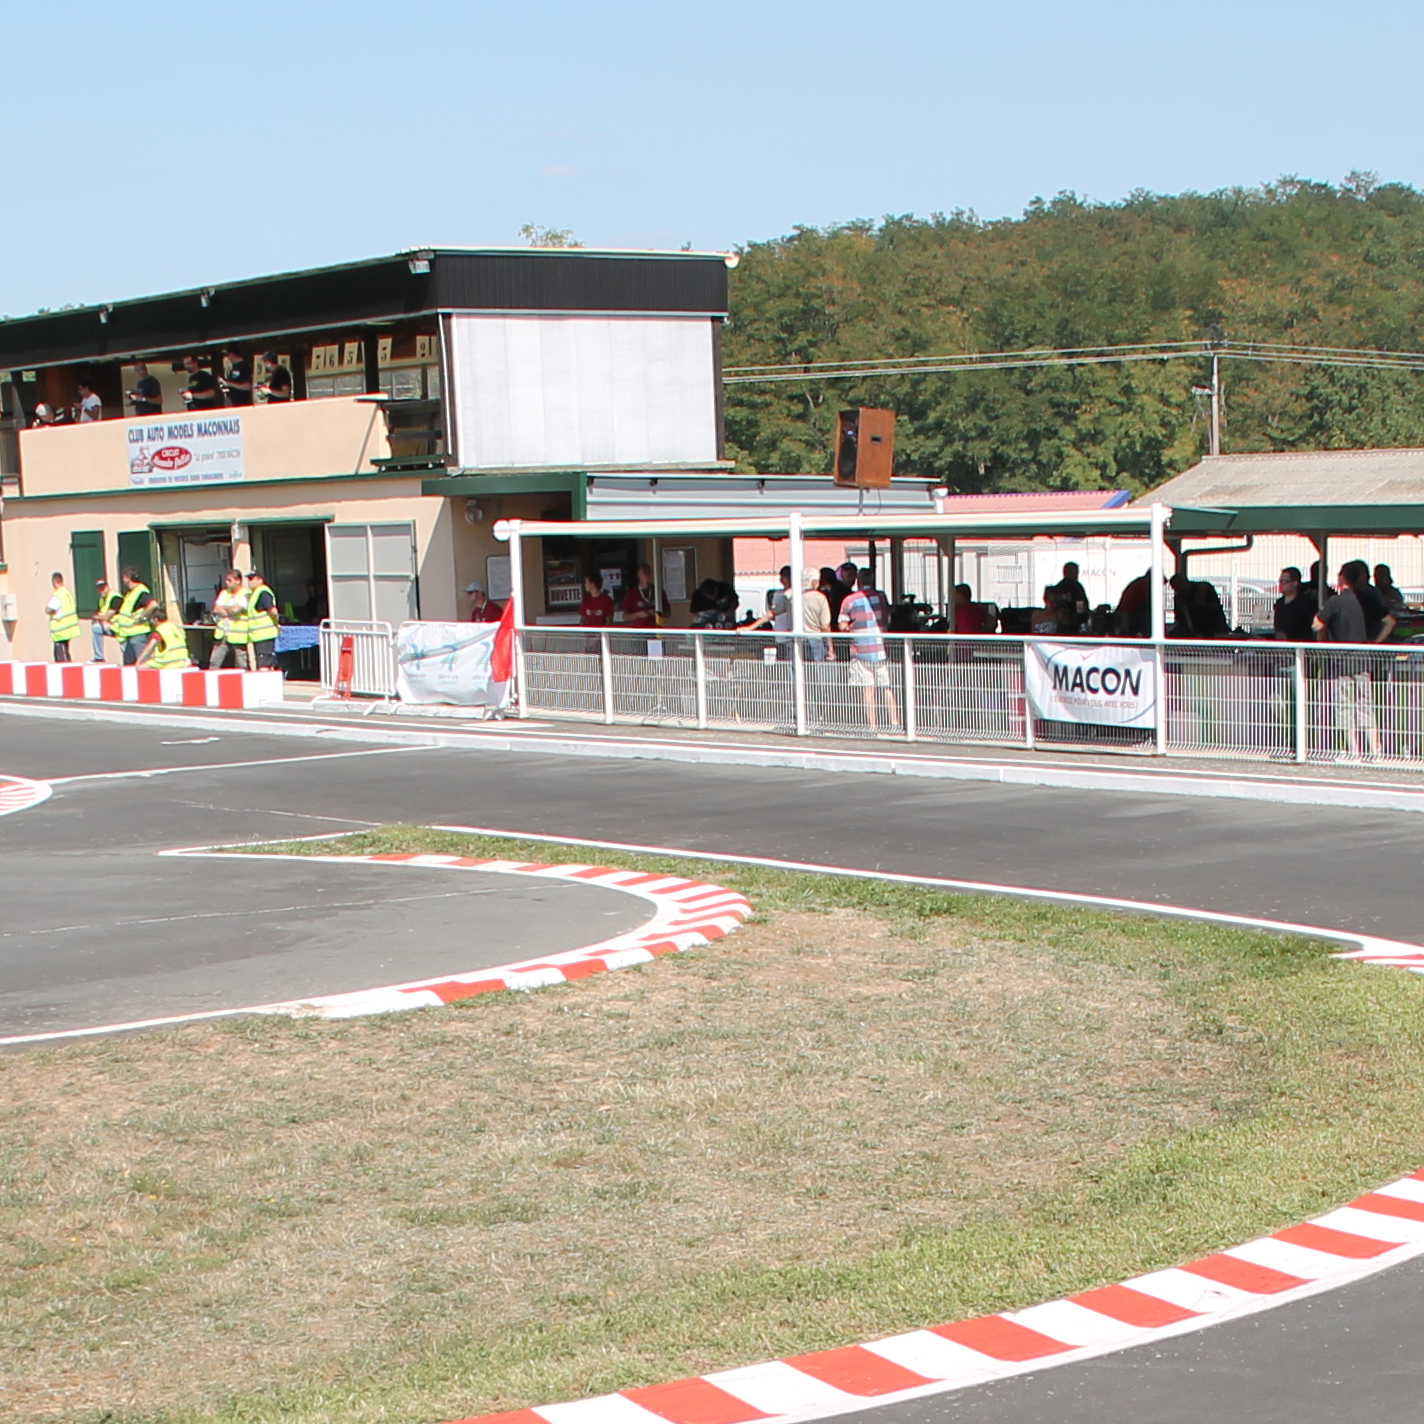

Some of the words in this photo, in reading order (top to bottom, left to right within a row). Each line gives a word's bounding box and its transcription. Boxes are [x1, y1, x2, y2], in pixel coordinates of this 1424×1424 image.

[128, 427, 144, 443] CLUB
[147, 426, 164, 442] AUTO
[167, 423, 194, 439] MODELS
[196, 418, 240, 437] MACONNAIS
[1053, 664, 1142, 696] MACON
